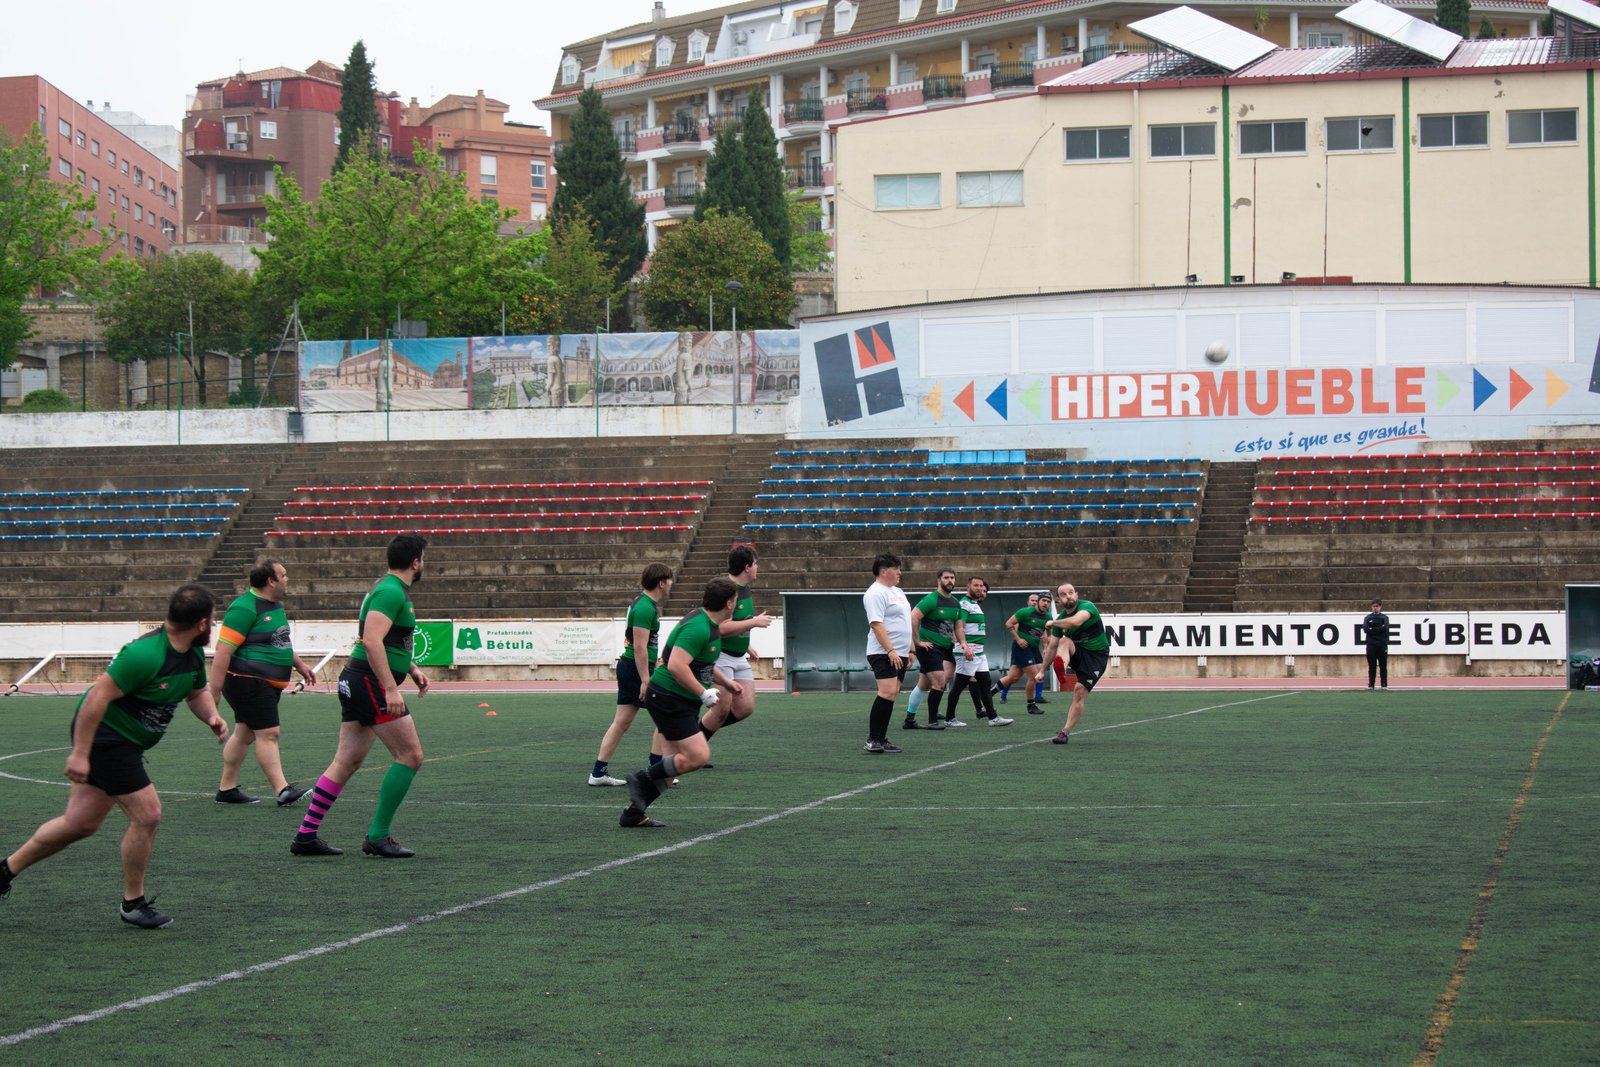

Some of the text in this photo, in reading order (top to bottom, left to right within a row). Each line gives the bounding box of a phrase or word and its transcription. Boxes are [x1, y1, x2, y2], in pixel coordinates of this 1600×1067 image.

[1057, 367, 1426, 419] HIPERMUEBLE
[1234, 434, 1273, 454] Esto
[1298, 433, 1328, 453] que
[1333, 431, 1351, 444] es
[1358, 418, 1427, 445] grande!
[487, 639, 533, 650] Bétula
[1414, 618, 1551, 645] ÚBEDA
